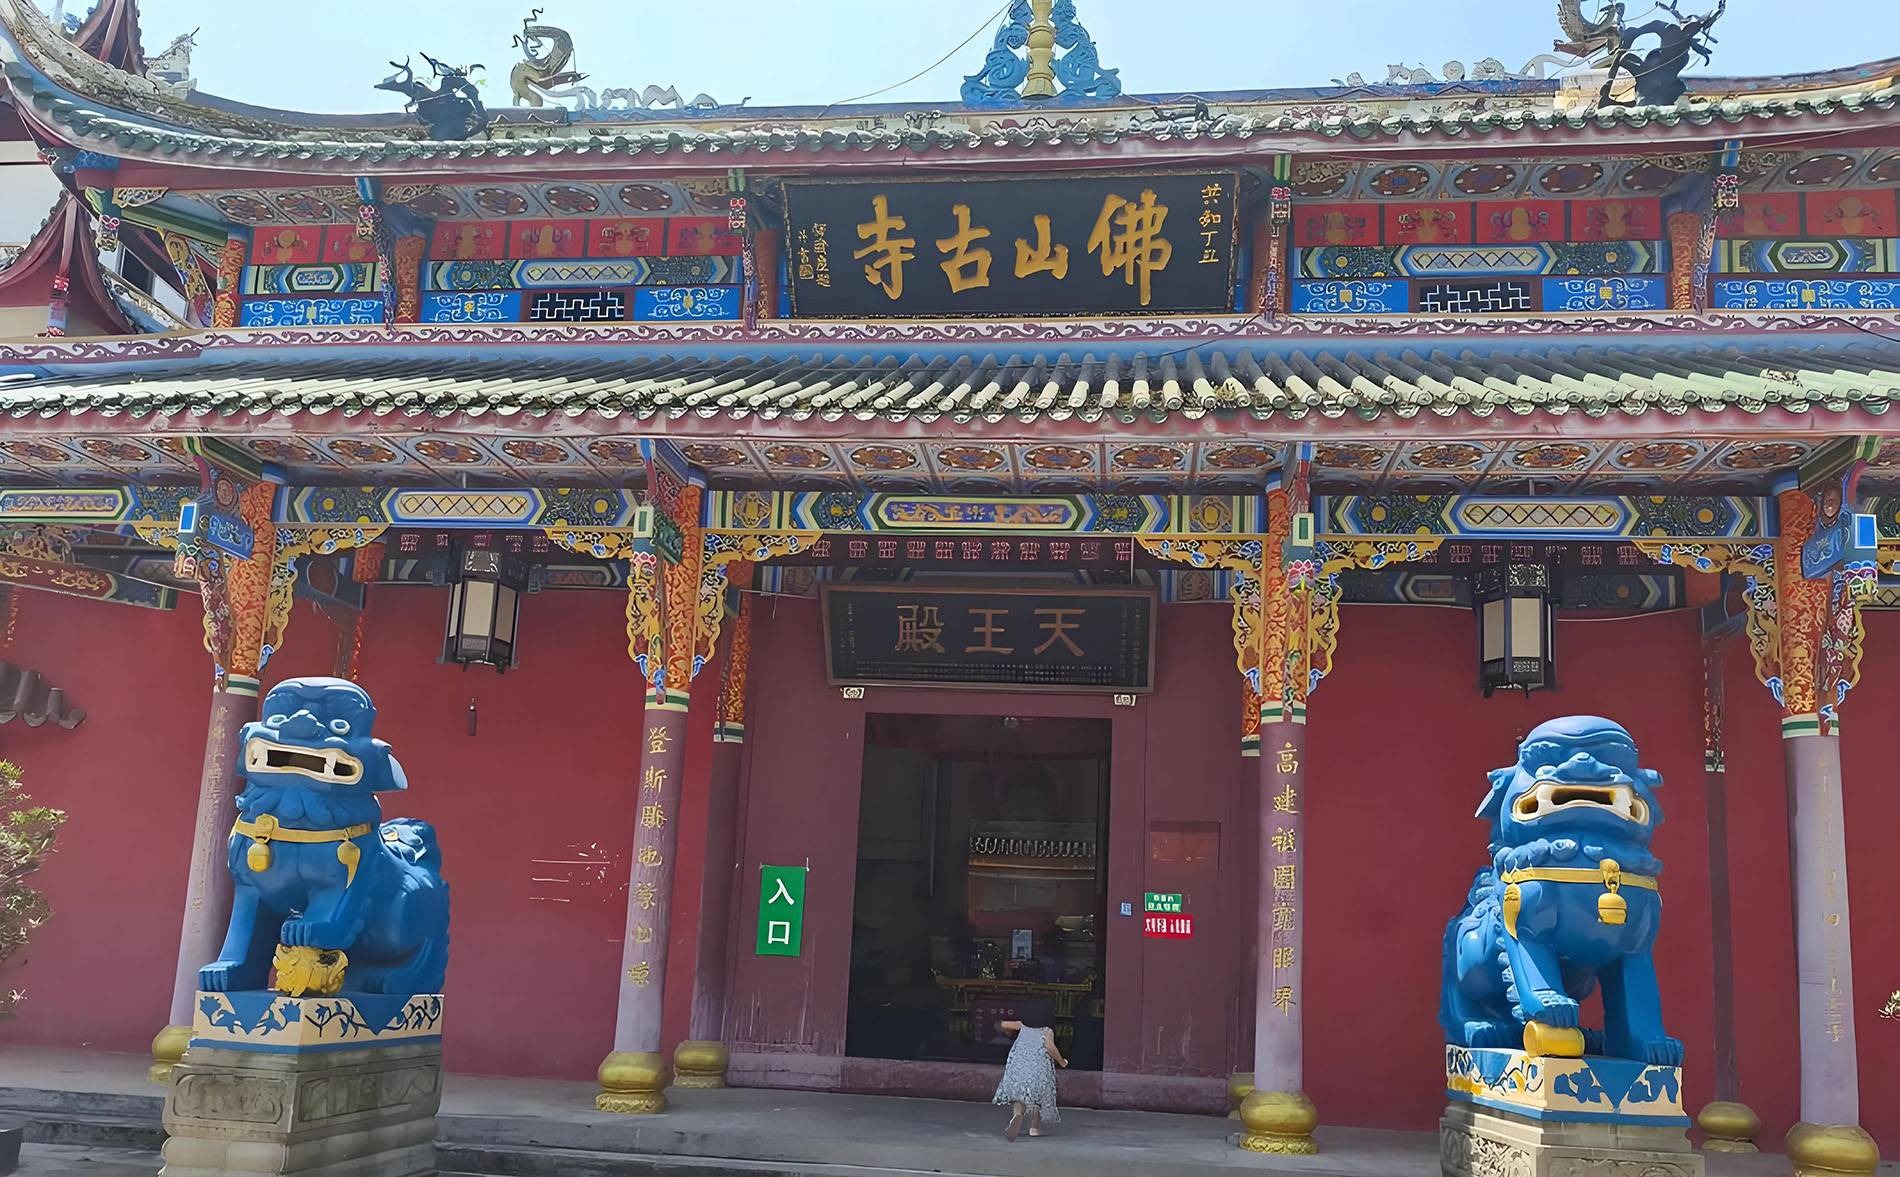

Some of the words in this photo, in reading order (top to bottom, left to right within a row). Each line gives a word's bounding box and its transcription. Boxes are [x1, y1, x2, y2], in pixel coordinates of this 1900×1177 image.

[852, 188, 1173, 306] 佛山古寺
[893, 603, 1086, 657] 天王殿
[767, 877, 795, 945] 入口
